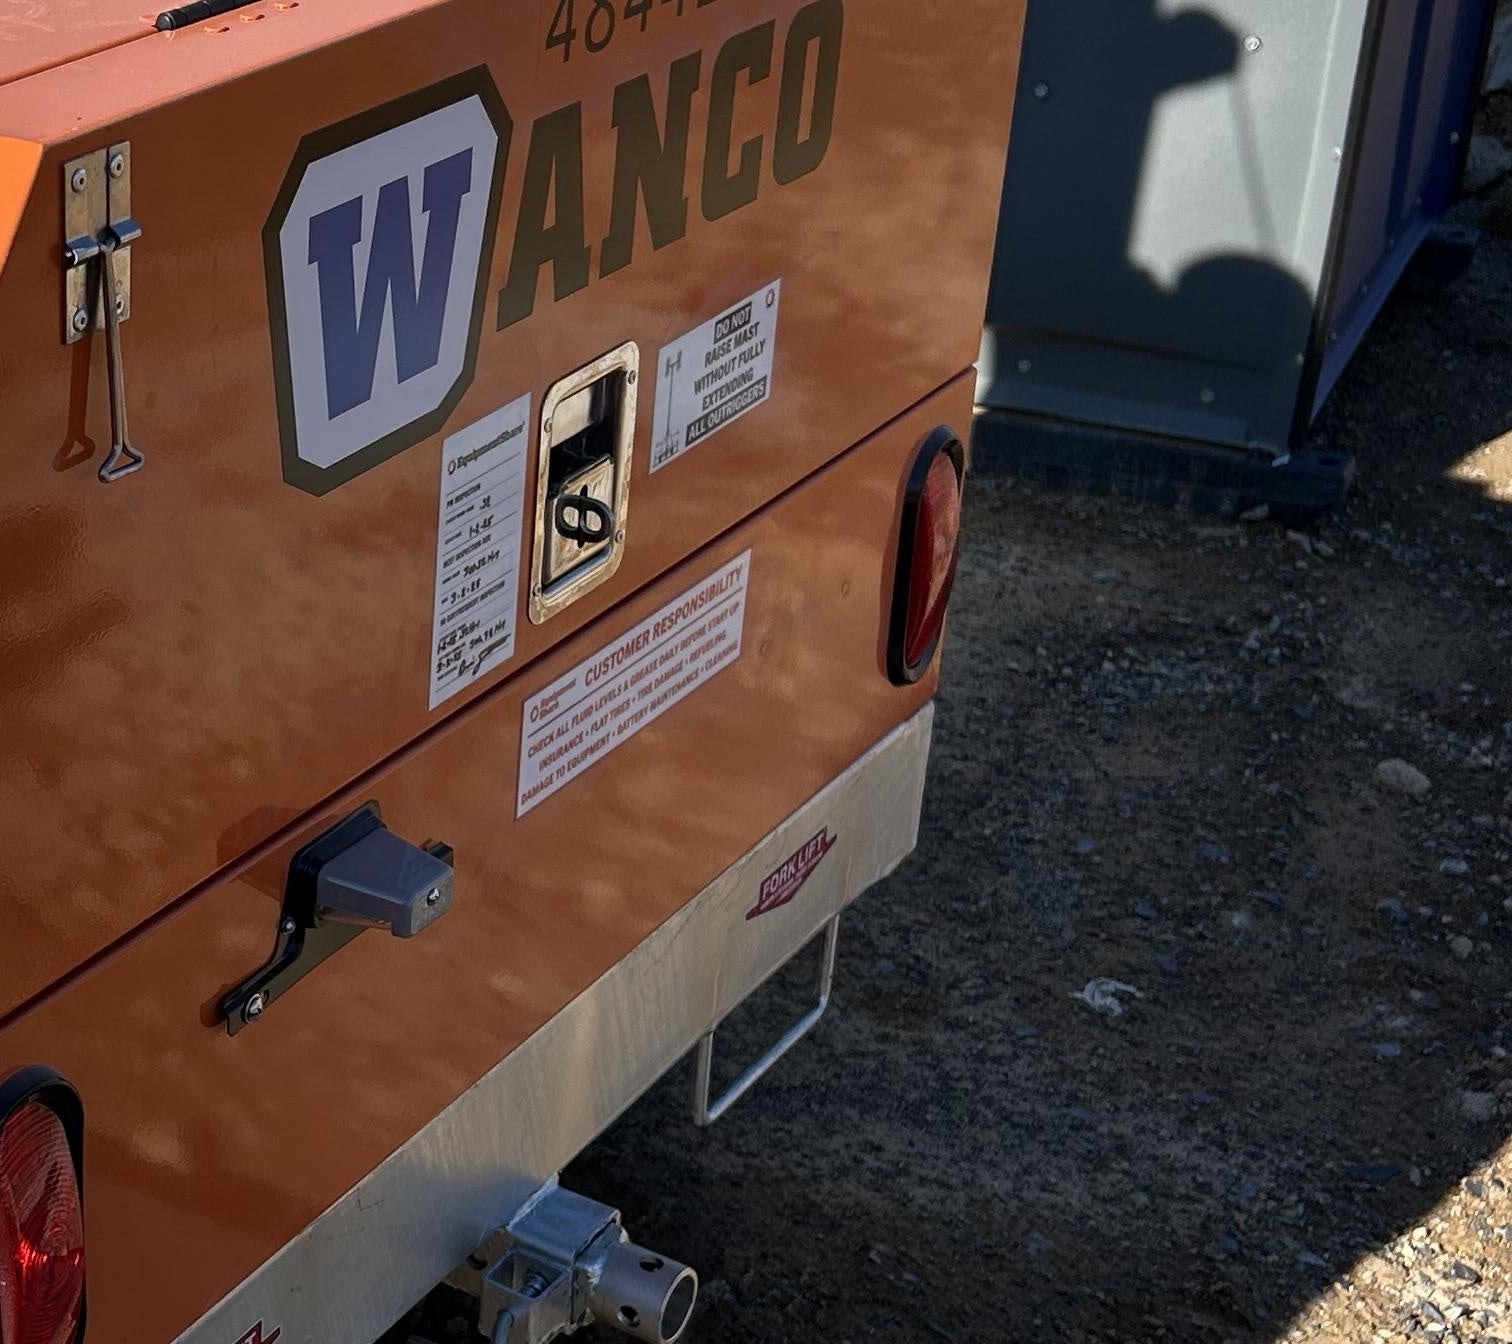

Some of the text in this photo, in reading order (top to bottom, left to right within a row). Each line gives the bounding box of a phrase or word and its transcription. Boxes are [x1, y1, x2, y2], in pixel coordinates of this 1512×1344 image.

[705, 321, 759, 367] RAISE MAST
[716, 305, 750, 338] DO NOT
[693, 338, 765, 395] WITHOUT FULLY
[703, 366, 753, 410] EXTENDING
[688, 378, 765, 441] ALL OUTRIGGERS
[585, 629, 649, 687] CUSTOMER
[653, 565, 741, 640] RESPONSIBILITY
[528, 729, 555, 759] CHECK
[556, 720, 568, 739] ALL
[572, 703, 592, 728] FLUID
[595, 683, 621, 712] LEVELS
[630, 657, 657, 686] GREASE
[659, 644, 677, 666] DAILY
[681, 624, 705, 651] BEFORE
[708, 609, 727, 631] START
[730, 601, 738, 615] UP
[539, 629, 726, 771] INSURANCE FLAT TIRES TIRE DAMAGE REFUELING
[521, 772, 553, 805] DAMAGE
[568, 732, 609, 771] EQUIPMENT
[618, 703, 649, 735] BATTERY
[651, 668, 699, 711] MAINTENANCE
[706, 641, 737, 671] CLEANING
[763, 857, 795, 900] FORK
[799, 833, 822, 869] LIFT
